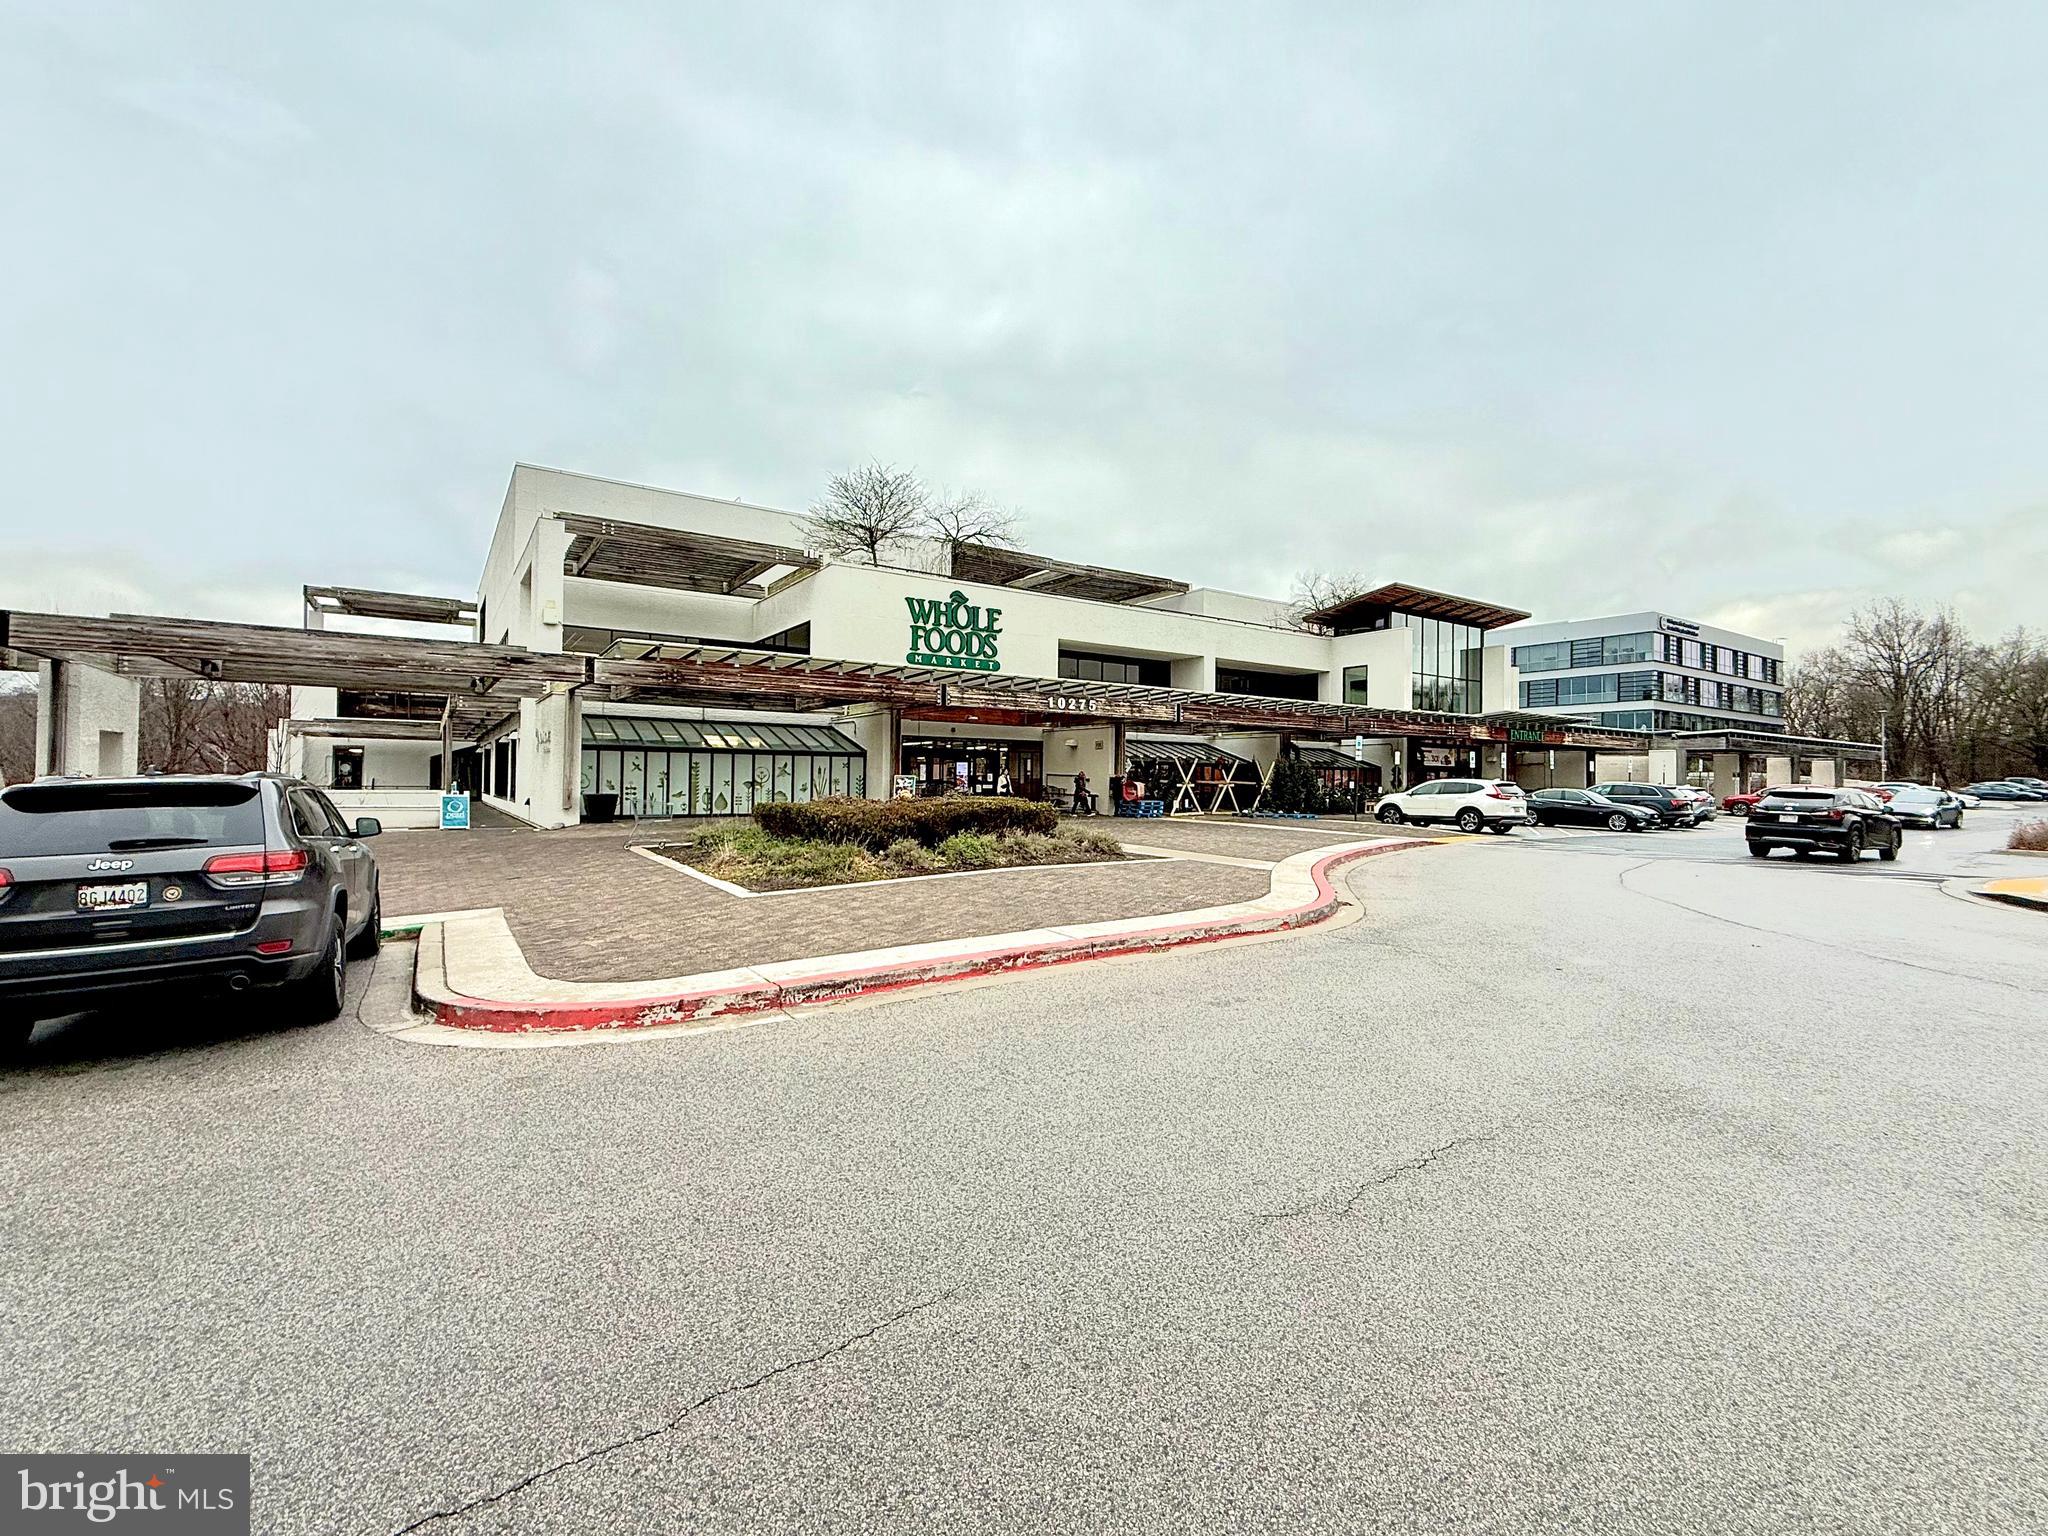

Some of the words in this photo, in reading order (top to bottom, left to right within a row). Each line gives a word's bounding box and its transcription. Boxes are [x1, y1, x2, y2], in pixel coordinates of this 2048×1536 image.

[905, 597, 1003, 633] WHOLE
[910, 625, 998, 659] FOODS
[915, 655, 994, 670] MARKET
[1048, 697, 1097, 711] 10275
[88, 859, 134, 871] Jeep
